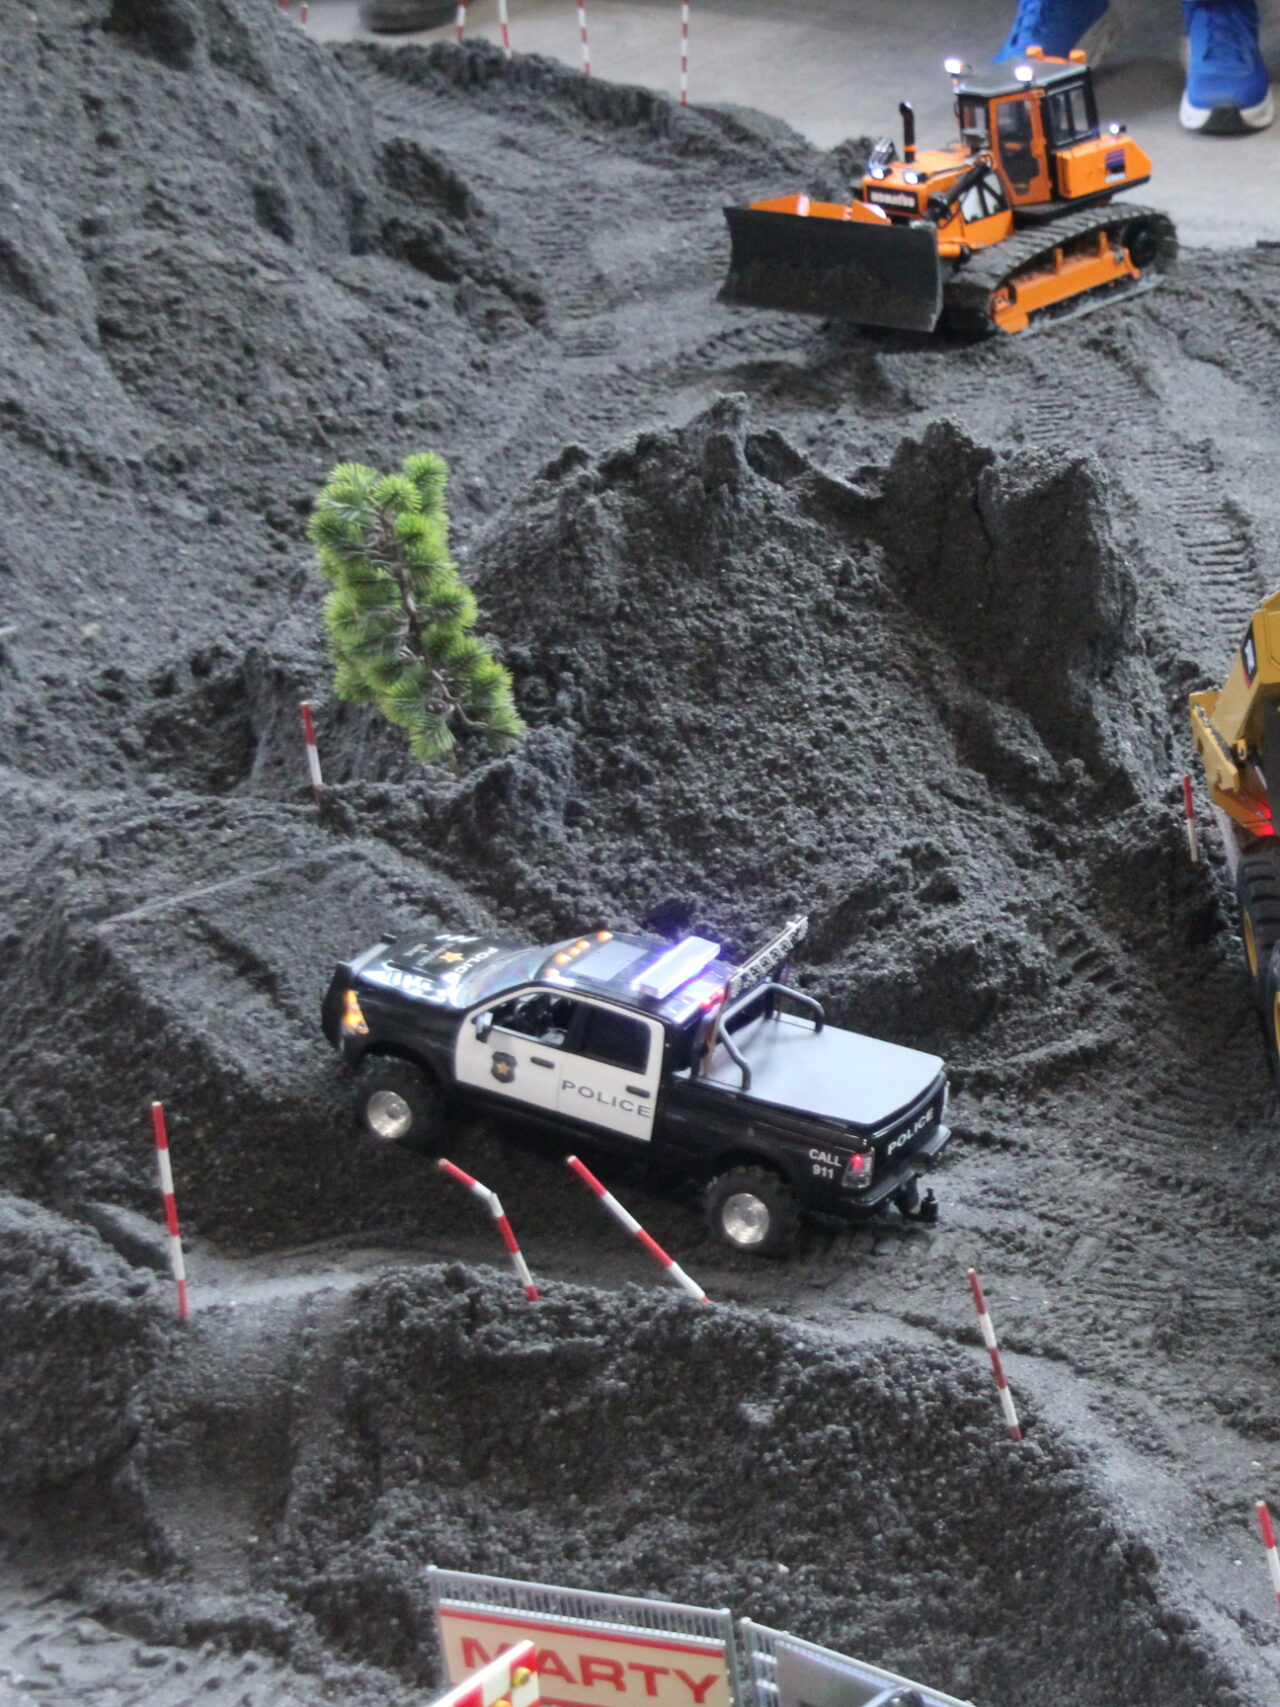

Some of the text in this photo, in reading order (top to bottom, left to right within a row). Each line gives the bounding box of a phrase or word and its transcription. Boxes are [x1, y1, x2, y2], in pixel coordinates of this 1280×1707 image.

[561, 1080, 651, 1118] POLICE
[887, 1107, 934, 1156] POLICE
[809, 1149, 842, 1168] CALL
[812, 1164, 835, 1180] 911
